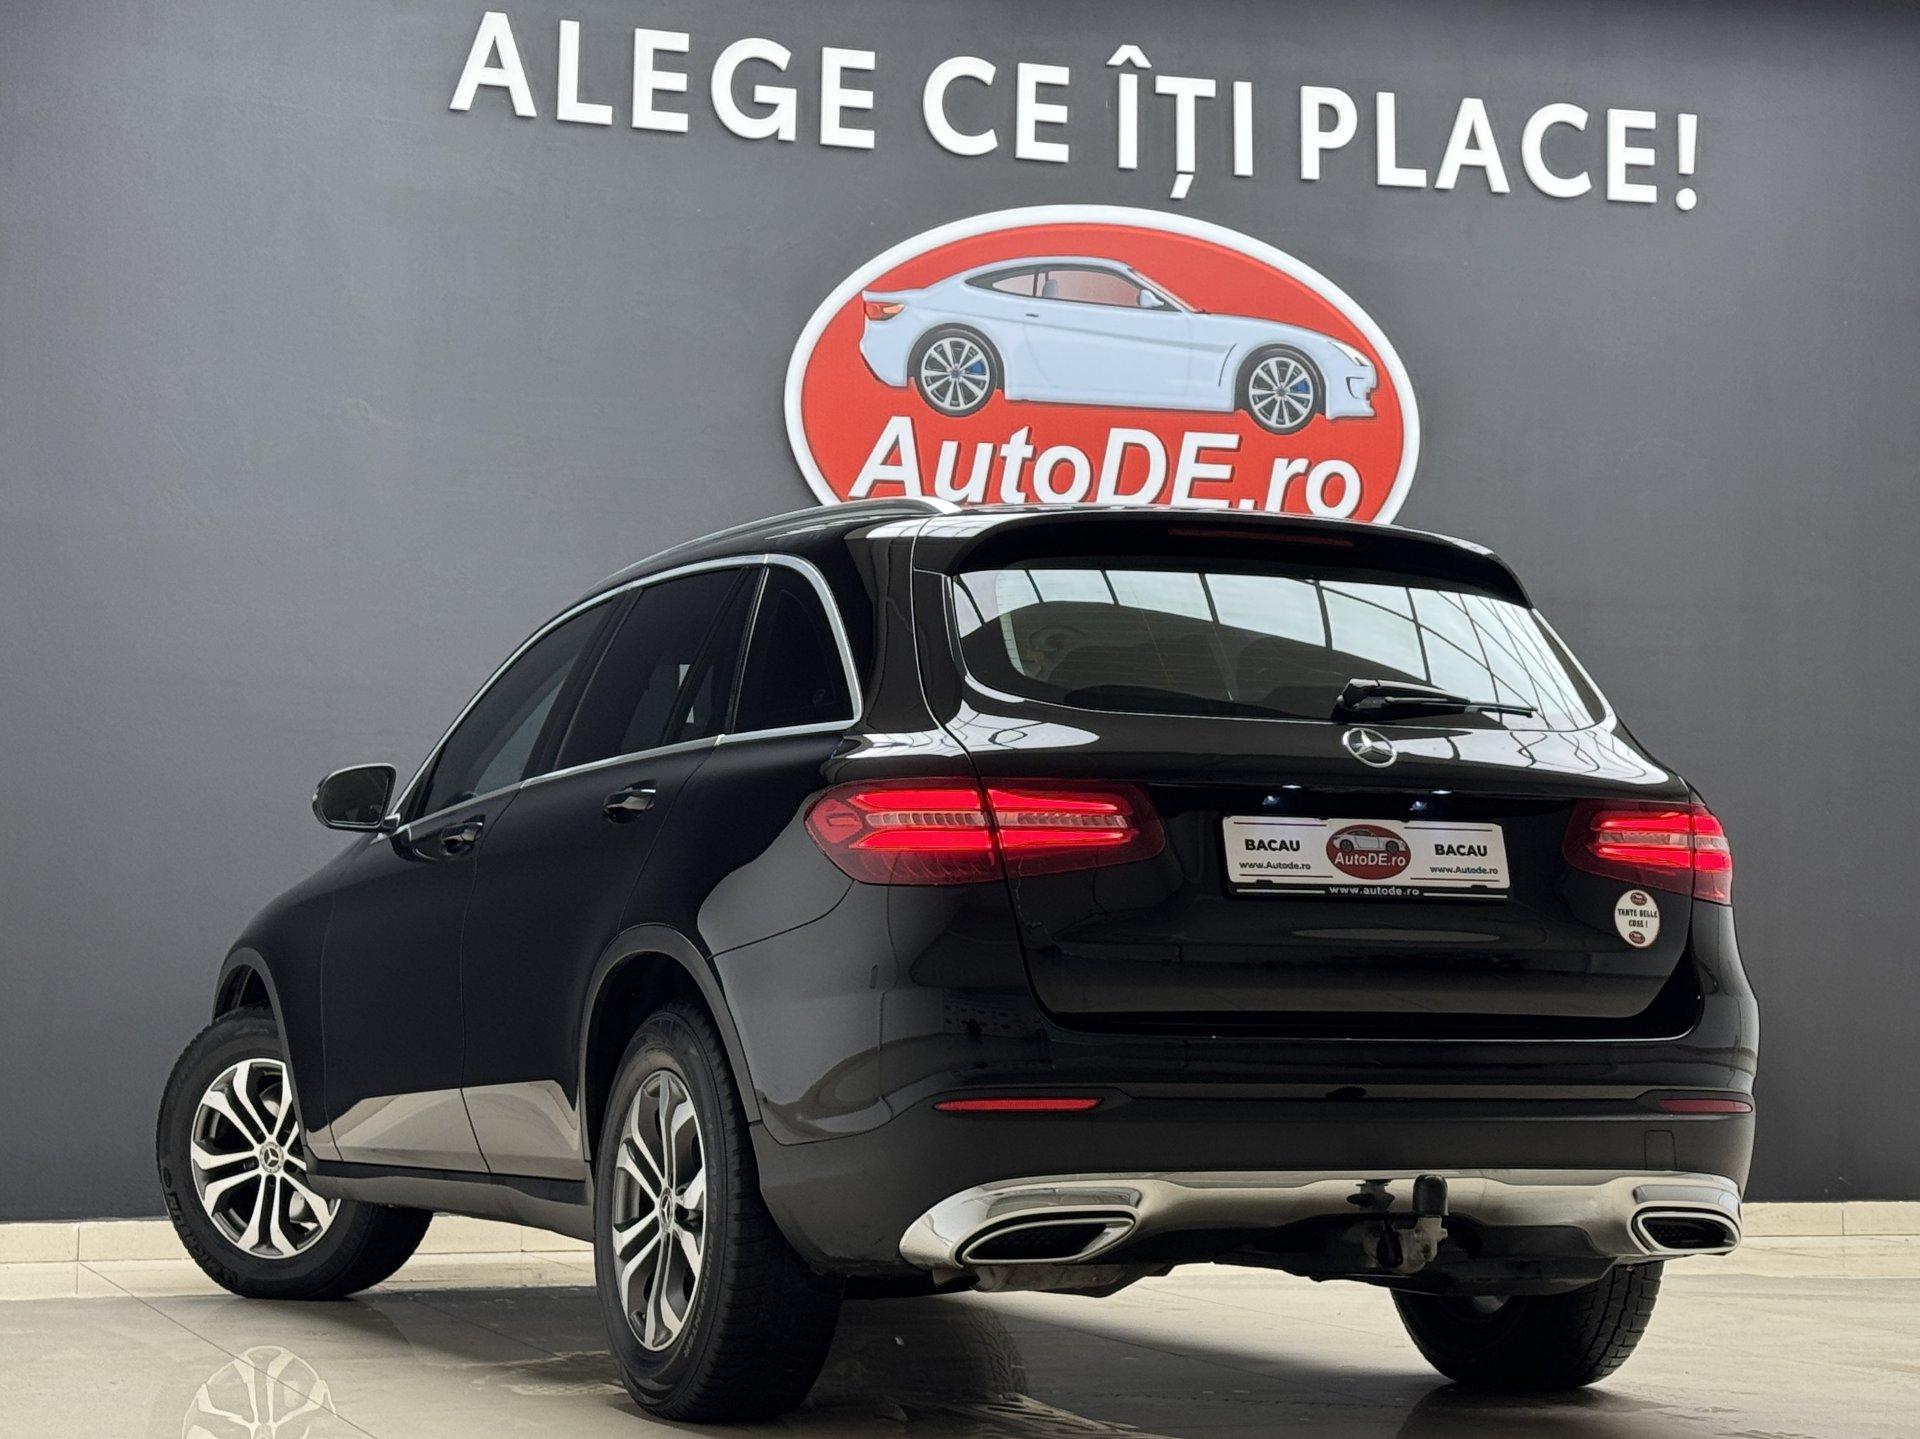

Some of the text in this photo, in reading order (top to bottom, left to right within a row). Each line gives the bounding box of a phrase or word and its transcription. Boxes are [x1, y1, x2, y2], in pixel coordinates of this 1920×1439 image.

[449, 10, 876, 149] ALEGE
[922, 56, 1070, 163] CE
[1300, 85, 1698, 211] PLACE!
[849, 415, 1361, 520] AutoDE.ro
[1244, 838, 1300, 852] BACAU
[1434, 843, 1488, 857] BACAU
[1239, 860, 1311, 870] www.Autode.ro
[1334, 852, 1406, 866] AutoDE.ro
[1429, 866, 1499, 875] www.Autode.ro
[1329, 886, 1420, 896] www.autode.ro
